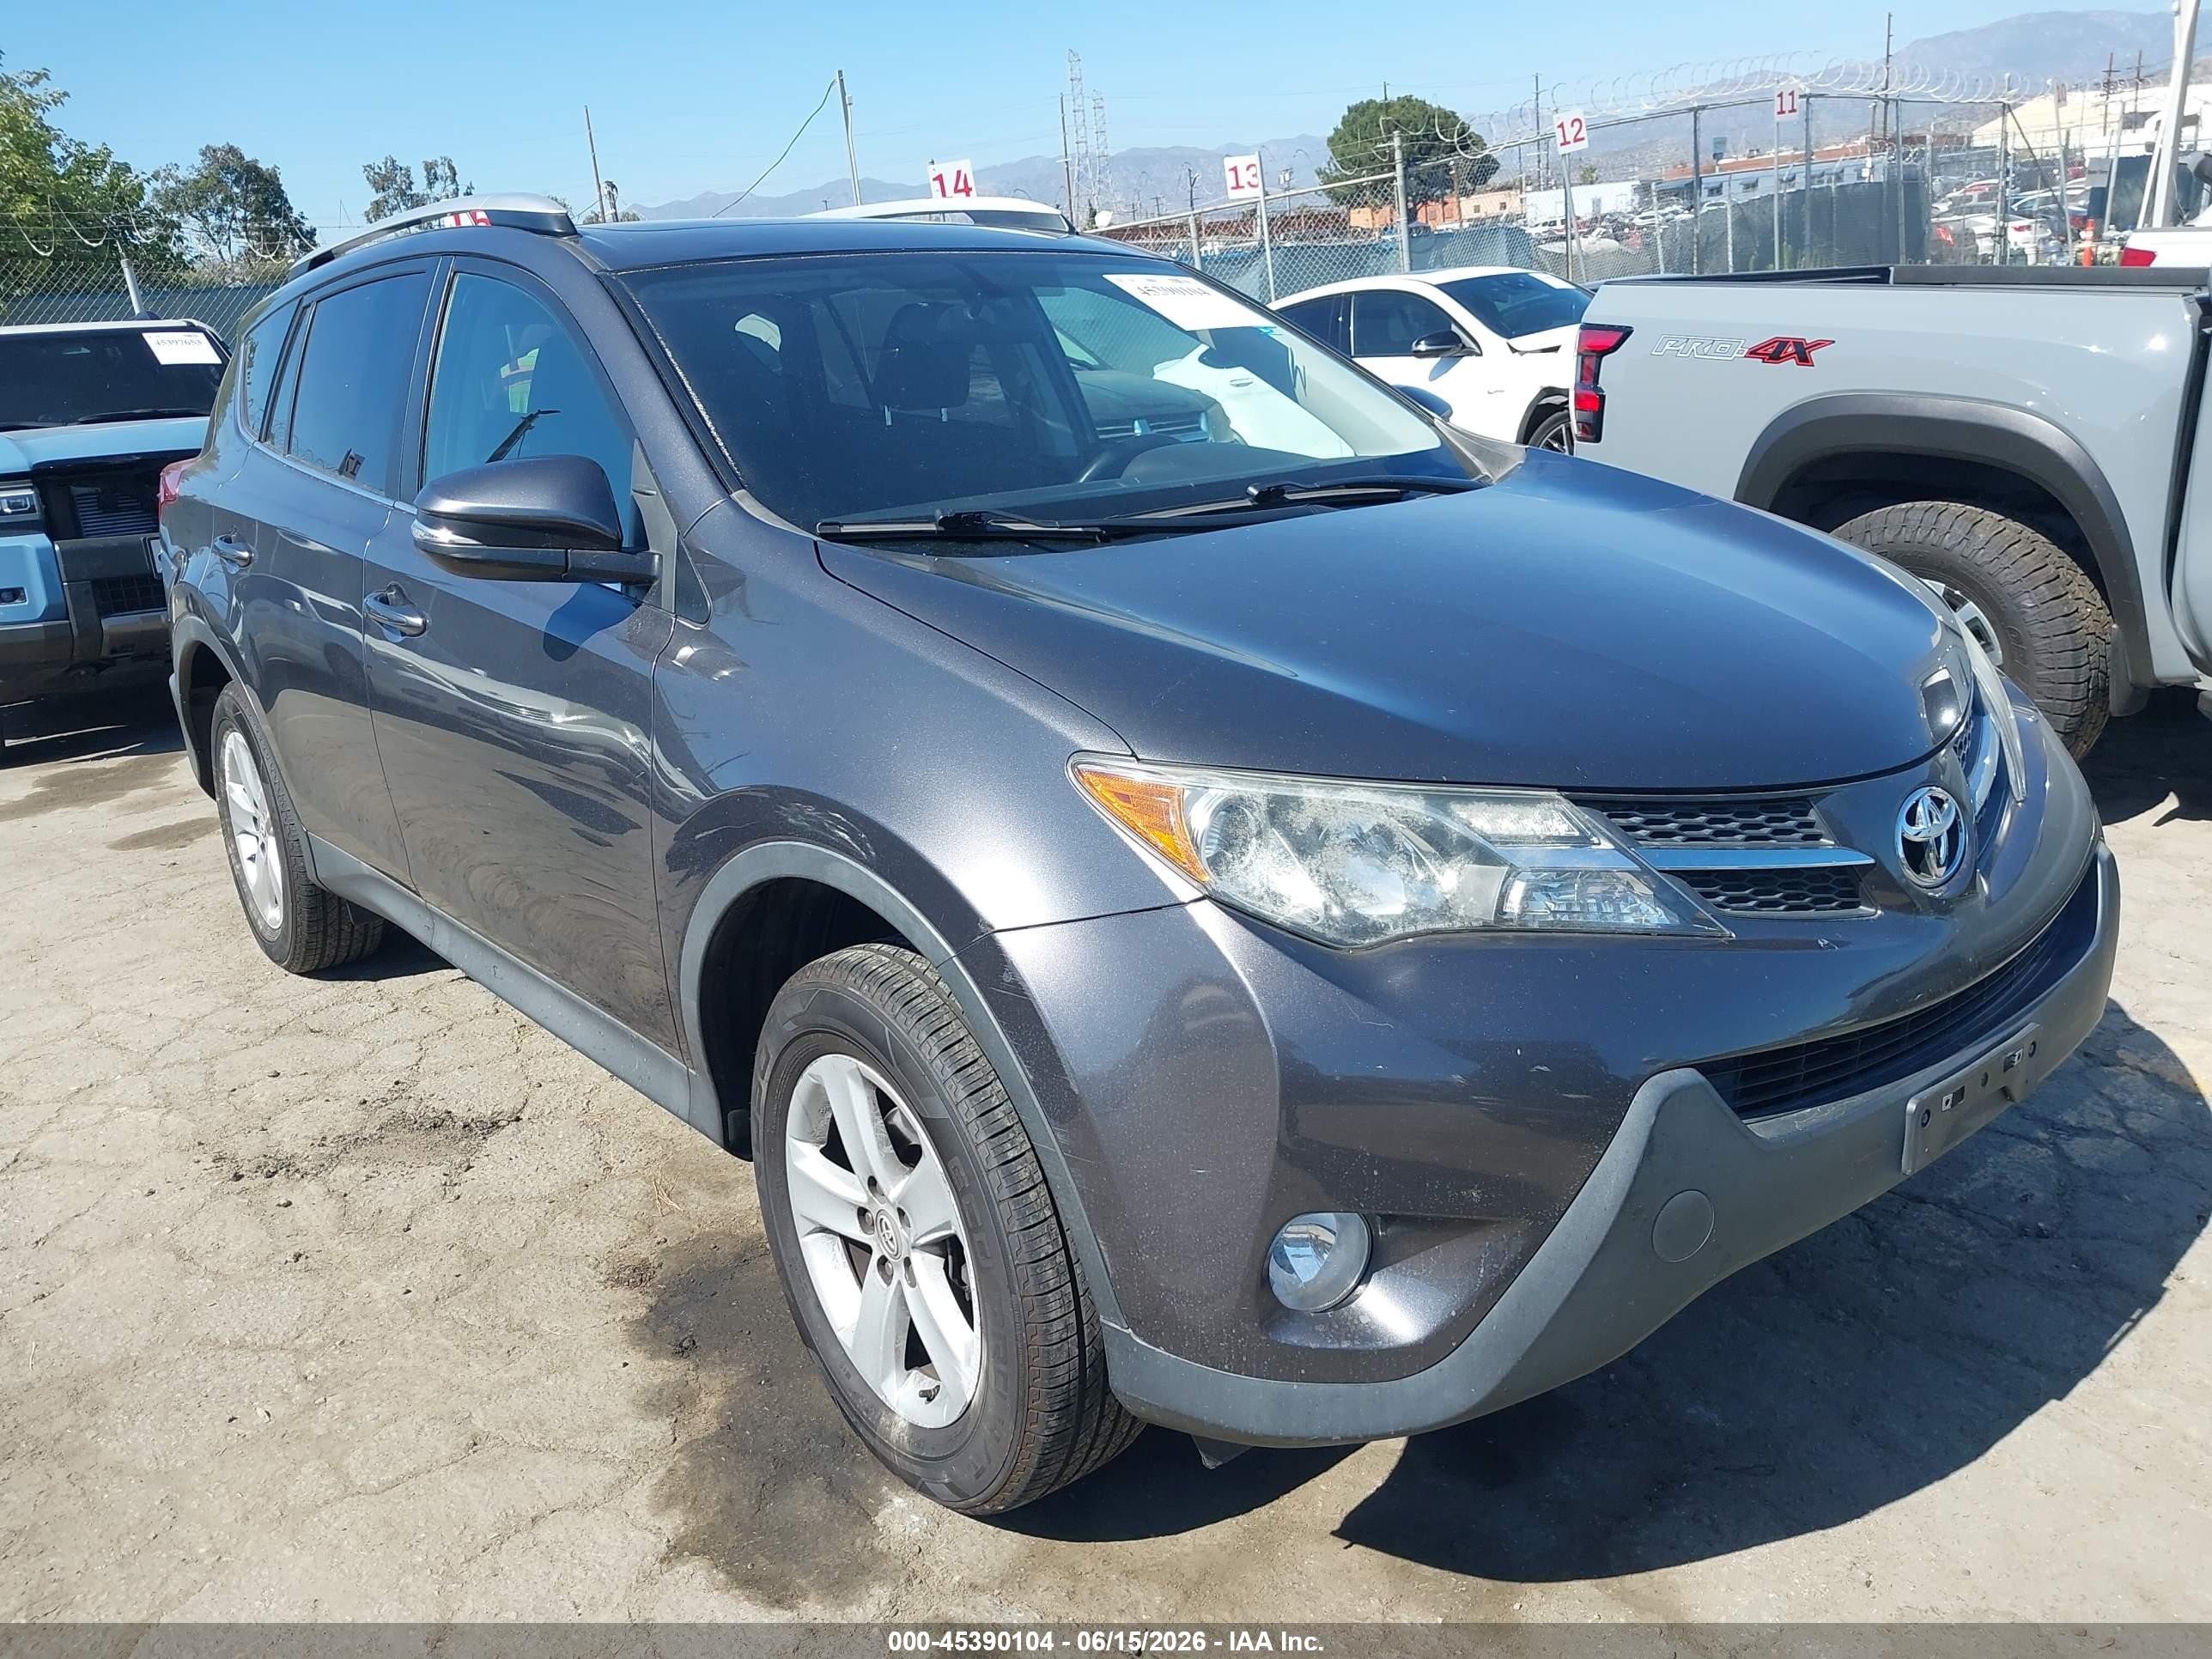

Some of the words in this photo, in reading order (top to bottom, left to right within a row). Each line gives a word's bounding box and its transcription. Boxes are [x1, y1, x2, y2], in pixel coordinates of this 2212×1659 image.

[1776, 89, 1798, 115] 11
[1556, 117, 1586, 147] 12
[932, 168, 973, 198] 14
[1228, 163, 1261, 191] 13
